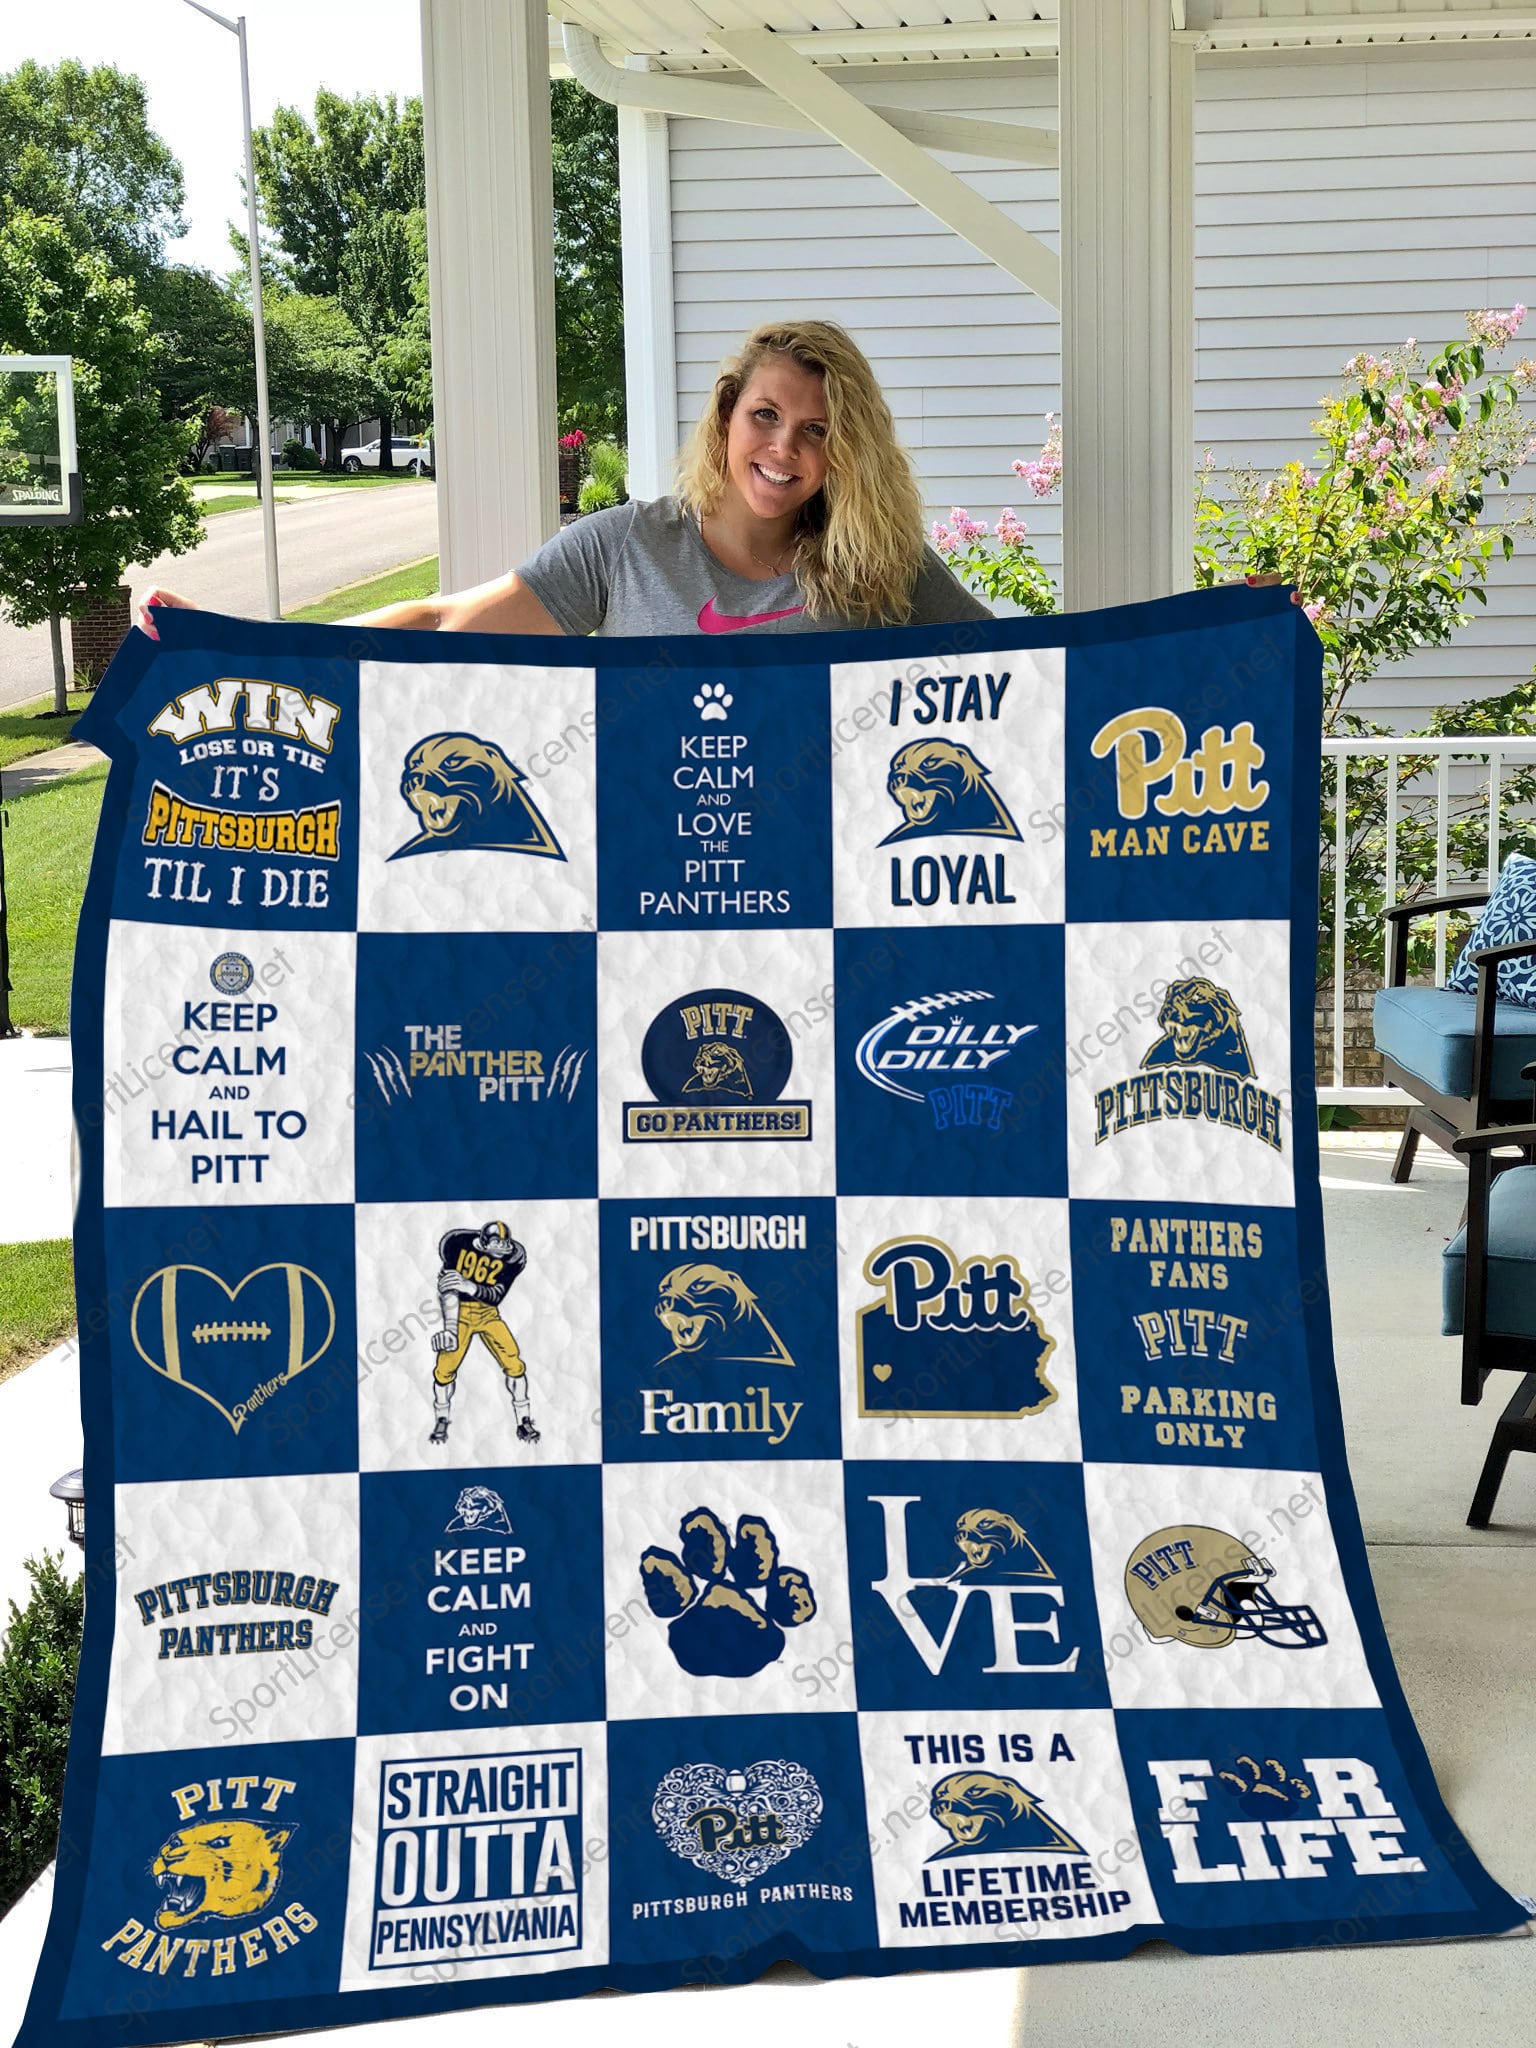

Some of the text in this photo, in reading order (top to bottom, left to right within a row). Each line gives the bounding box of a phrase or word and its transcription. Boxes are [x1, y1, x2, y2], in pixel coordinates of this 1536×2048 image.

[12, 489, 61, 502] SPALDING
[147, 677, 341, 753] WIN
[889, 672, 1011, 726] I STAY
[180, 739, 326, 773] LOSE OR TIE
[680, 735, 748, 759] KEEP
[1090, 706, 1270, 820] Pitt
[211, 765, 280, 802] IT'S
[673, 766, 754, 790] CALM
[697, 794, 731, 806] AND
[142, 779, 341, 862] PITTSBURGH
[677, 812, 752, 836] LOVE
[700, 840, 729, 853] THE
[1090, 821, 1270, 858] MAN CAVE
[144, 857, 330, 909] TIL I DIE
[685, 860, 745, 883] PITT
[891, 853, 1017, 907] LOYAL
[639, 890, 790, 915] PANTHERS
[183, 1001, 278, 1032] KEEP
[679, 1001, 754, 1041] PITT
[404, 1025, 462, 1051] THE
[905, 1023, 1039, 1047] DILLY
[171, 1045, 286, 1076] CALM
[410, 1050, 545, 1078] PANTHER
[876, 1049, 1012, 1072] DILLY
[208, 1085, 250, 1101] AND
[479, 1076, 545, 1103] PITT
[927, 1084, 1014, 1131] PITT
[151, 1110, 308, 1141] HAIL TO
[636, 1111, 802, 1134] GO PANTHERS!
[1094, 1066, 1283, 1152] PITTSBURGH
[191, 1154, 270, 1184] PITT
[630, 1214, 807, 1251] PITTSBURGH
[1110, 1216, 1263, 1259] PANTHERS
[456, 1248, 504, 1286] 1962
[1150, 1261, 1229, 1290] FANS
[870, 1240, 1032, 1332] Pitt
[1133, 1308, 1249, 1364] PITT
[232, 1372, 288, 1423] Panthers
[639, 1386, 804, 1445] Family
[1120, 1385, 1277, 1421] PARKING
[1156, 1421, 1246, 1449] ONLY
[433, 1546, 527, 1577] KEEP
[1130, 1538, 1200, 1592] PITT
[134, 1569, 341, 1626] PITTSBURGH
[427, 1582, 532, 1614] CALM
[158, 1618, 313, 1660] PANTHERS
[458, 1622, 498, 1638] AND
[426, 1642, 535, 1676] FIGHT
[449, 1683, 510, 1712] ON
[904, 1733, 1076, 1765] THIS IS A
[171, 1775, 297, 1821] PITT
[387, 1761, 574, 1821] STRAIGHT
[685, 1805, 790, 1853] Pitt
[382, 1819, 577, 1908] OUTTA
[1160, 1817, 1428, 1884] LIFE
[922, 1862, 1097, 1898] LIFETIME
[632, 1883, 853, 1920] PITTSBURGH PANTHERS
[900, 1889, 1131, 1930] MEMBERSHIP
[101, 1901, 319, 1978] PANTHERS
[376, 1904, 576, 1956] PENNSYLVANIA
